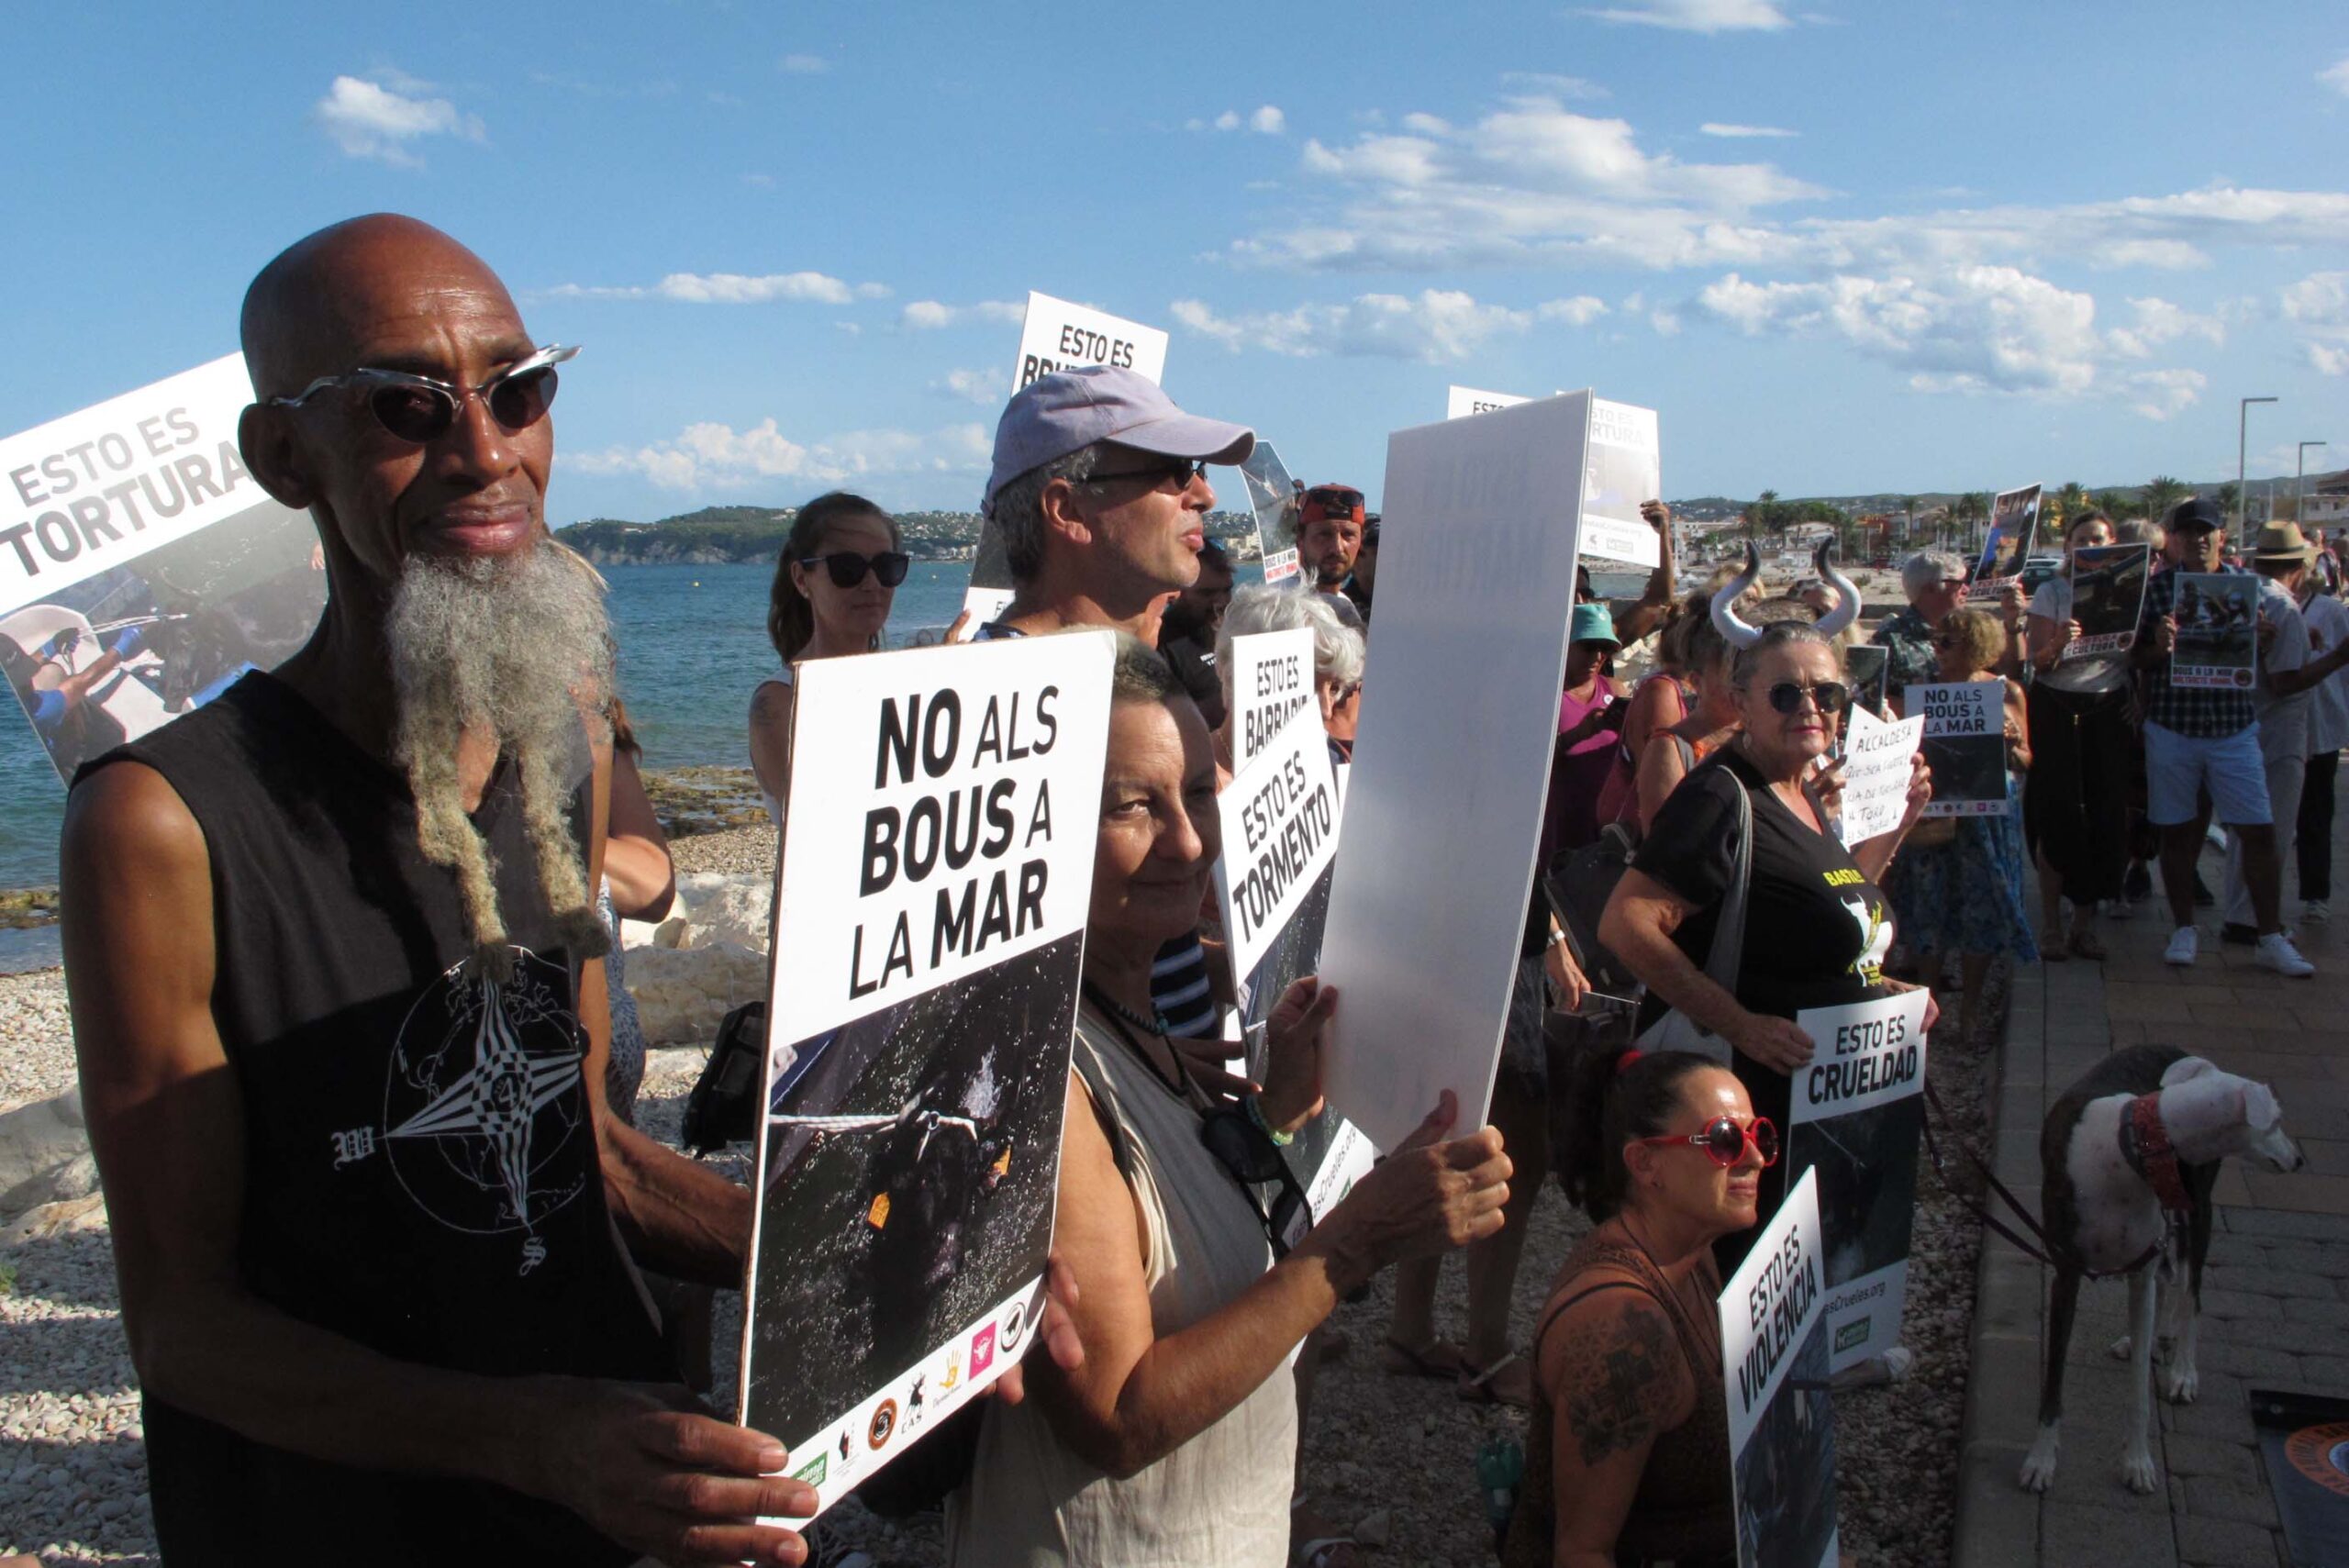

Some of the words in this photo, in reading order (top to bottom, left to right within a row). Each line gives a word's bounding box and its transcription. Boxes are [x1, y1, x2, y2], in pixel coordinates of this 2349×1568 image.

[1059, 324, 1107, 363] ESTO
[1110, 339, 1135, 370] ES
[1591, 406, 1614, 425] STO
[1592, 422, 1645, 446] RTURA
[8, 430, 134, 508] ESTO
[136, 406, 200, 453] ES
[0, 439, 256, 577] TORTURA
[1257, 659, 1284, 697] ESTO
[1286, 655, 1299, 689] ES
[1924, 705, 1971, 719] BOUS
[1975, 706, 1985, 717] A
[1925, 689, 1949, 704] NO
[1954, 689, 1982, 703] ALS
[874, 688, 962, 790] NO
[973, 684, 1059, 769] ALS
[1924, 720, 1943, 734] LA
[1946, 718, 1986, 732] MAR
[859, 777, 1017, 898] BOUS
[1025, 778, 1052, 848] A
[1241, 774, 1284, 854] ESTO
[1285, 750, 1306, 801] ES
[1232, 783, 1331, 943] TORMENTO
[849, 909, 914, 1001] LA
[930, 858, 1049, 970] MAR
[1808, 1044, 1918, 1106] CRUELDAD
[1835, 1020, 1882, 1056] ESTO
[1886, 1014, 1906, 1044] ES
[1748, 1251, 1783, 1333] ESTO
[1784, 1223, 1801, 1273] ES
[1737, 1254, 1817, 1416] VIOLENCIA
